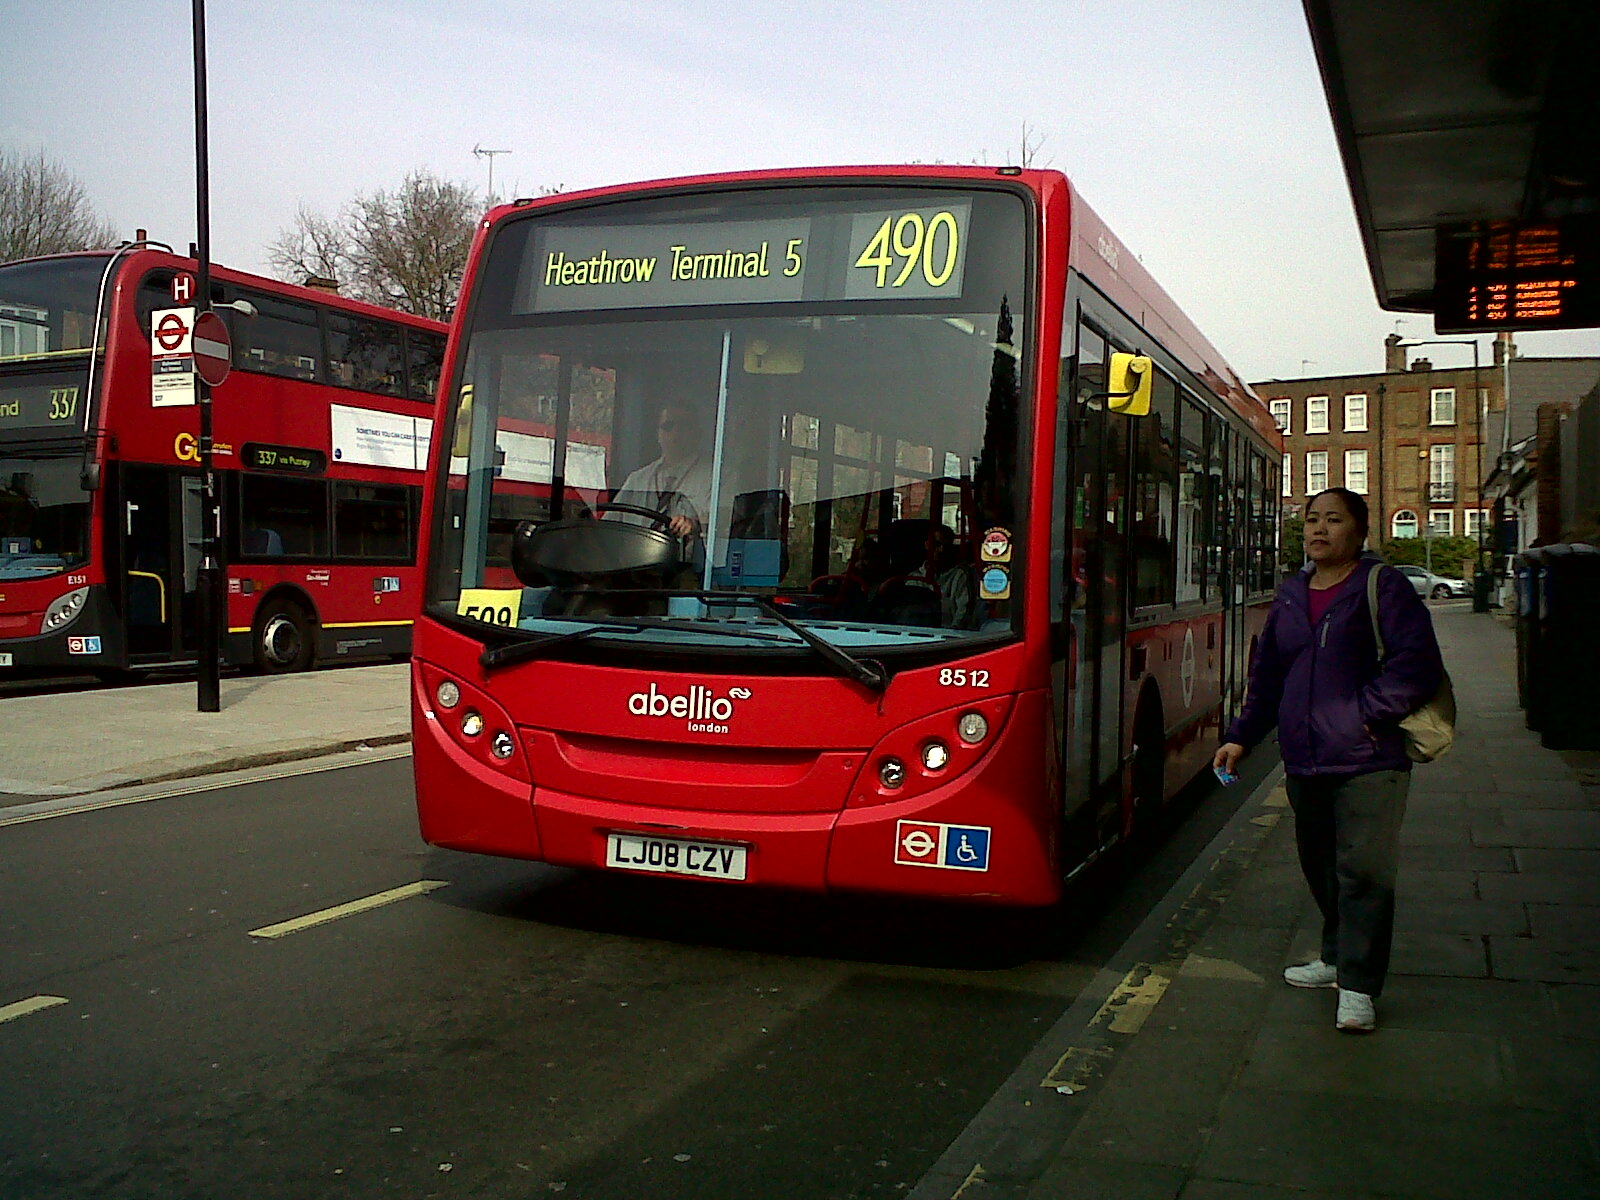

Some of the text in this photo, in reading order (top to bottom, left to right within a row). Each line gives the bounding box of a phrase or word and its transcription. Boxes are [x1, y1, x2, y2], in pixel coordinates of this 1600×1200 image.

[854, 211, 959, 288] 490
[544, 239, 803, 286] Heathrow Terminal 5
[173, 277, 189, 300] H
[48, 387, 79, 420] 337
[258, 450, 277, 465] 337
[68, 575, 87, 585] E151
[466, 606, 512, 627] 509
[939, 668, 990, 688] 8512
[628, 682, 733, 721] abellio
[687, 721, 729, 734] london
[615, 837, 734, 874] LJ08 CZV
